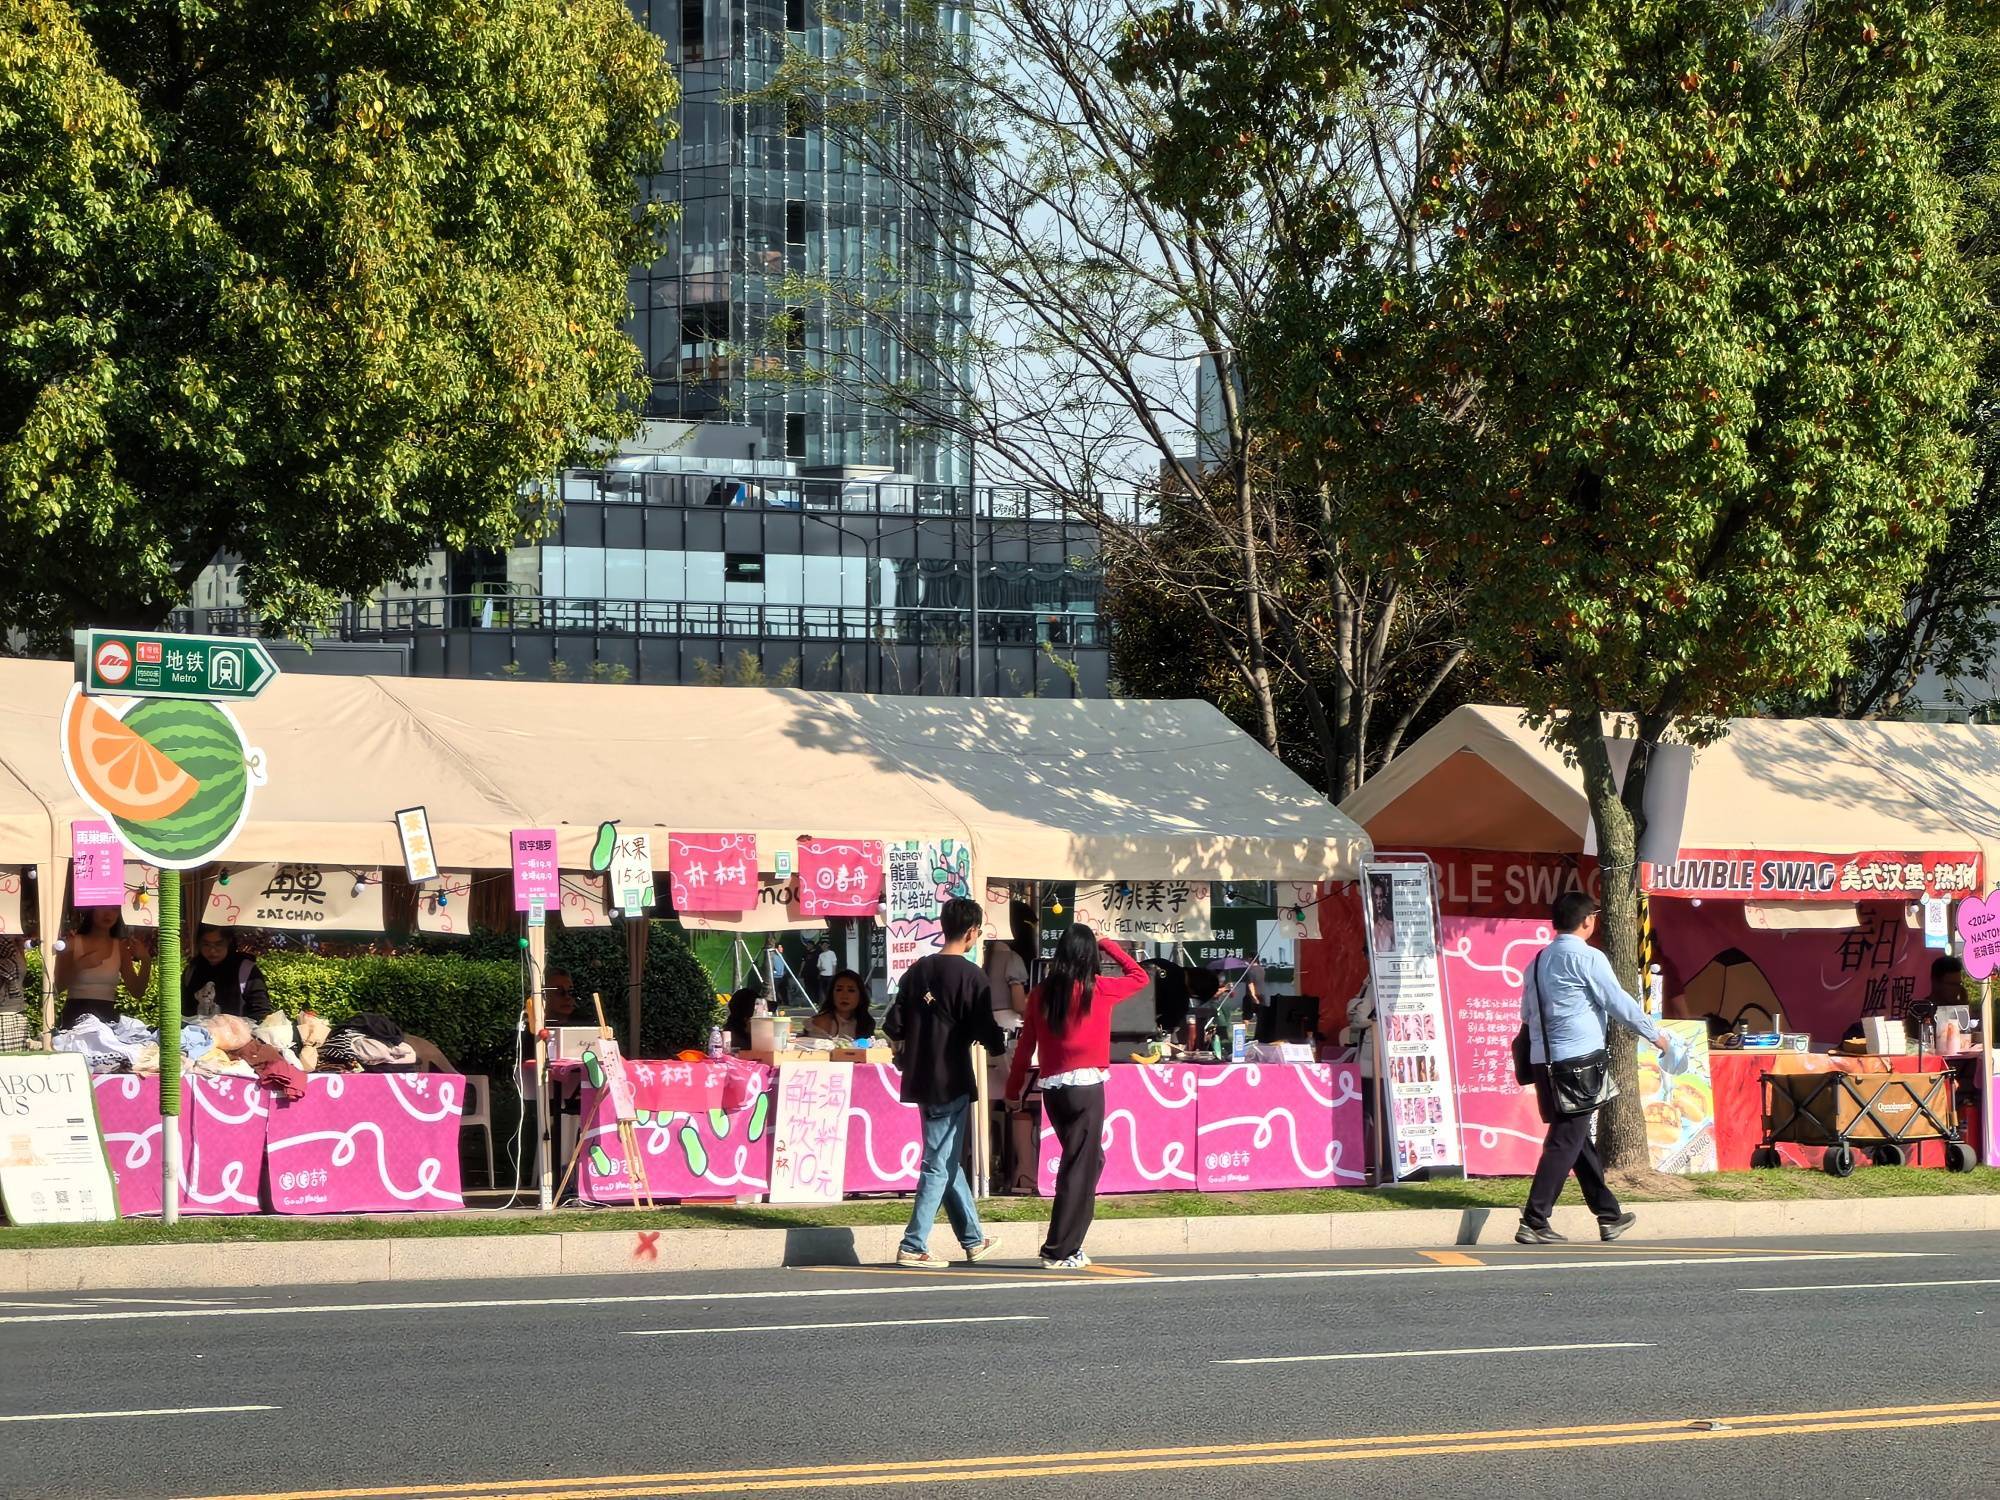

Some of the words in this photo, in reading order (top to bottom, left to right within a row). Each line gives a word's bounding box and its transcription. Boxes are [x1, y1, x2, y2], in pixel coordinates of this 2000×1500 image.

[166, 649, 204, 672] 地铁
[171, 673, 197, 684] Metro
[612, 836, 649, 861] 水果
[889, 851, 923, 862] ENERGY
[617, 867, 651, 885] 15元
[683, 857, 748, 889] 朴树
[889, 862, 920, 882] 能量
[1649, 859, 1756, 891] HUMBLE
[1760, 861, 1835, 892] SWAG
[891, 881, 925, 891] STATION
[890, 890, 935, 911] 补给站
[1114, 917, 1133, 933] FEI
[1134, 920, 1160, 934] MEI
[1161, 920, 1186, 934] XUE
[892, 942, 917, 953] KEEP
[0, 1095, 30, 1116] US
